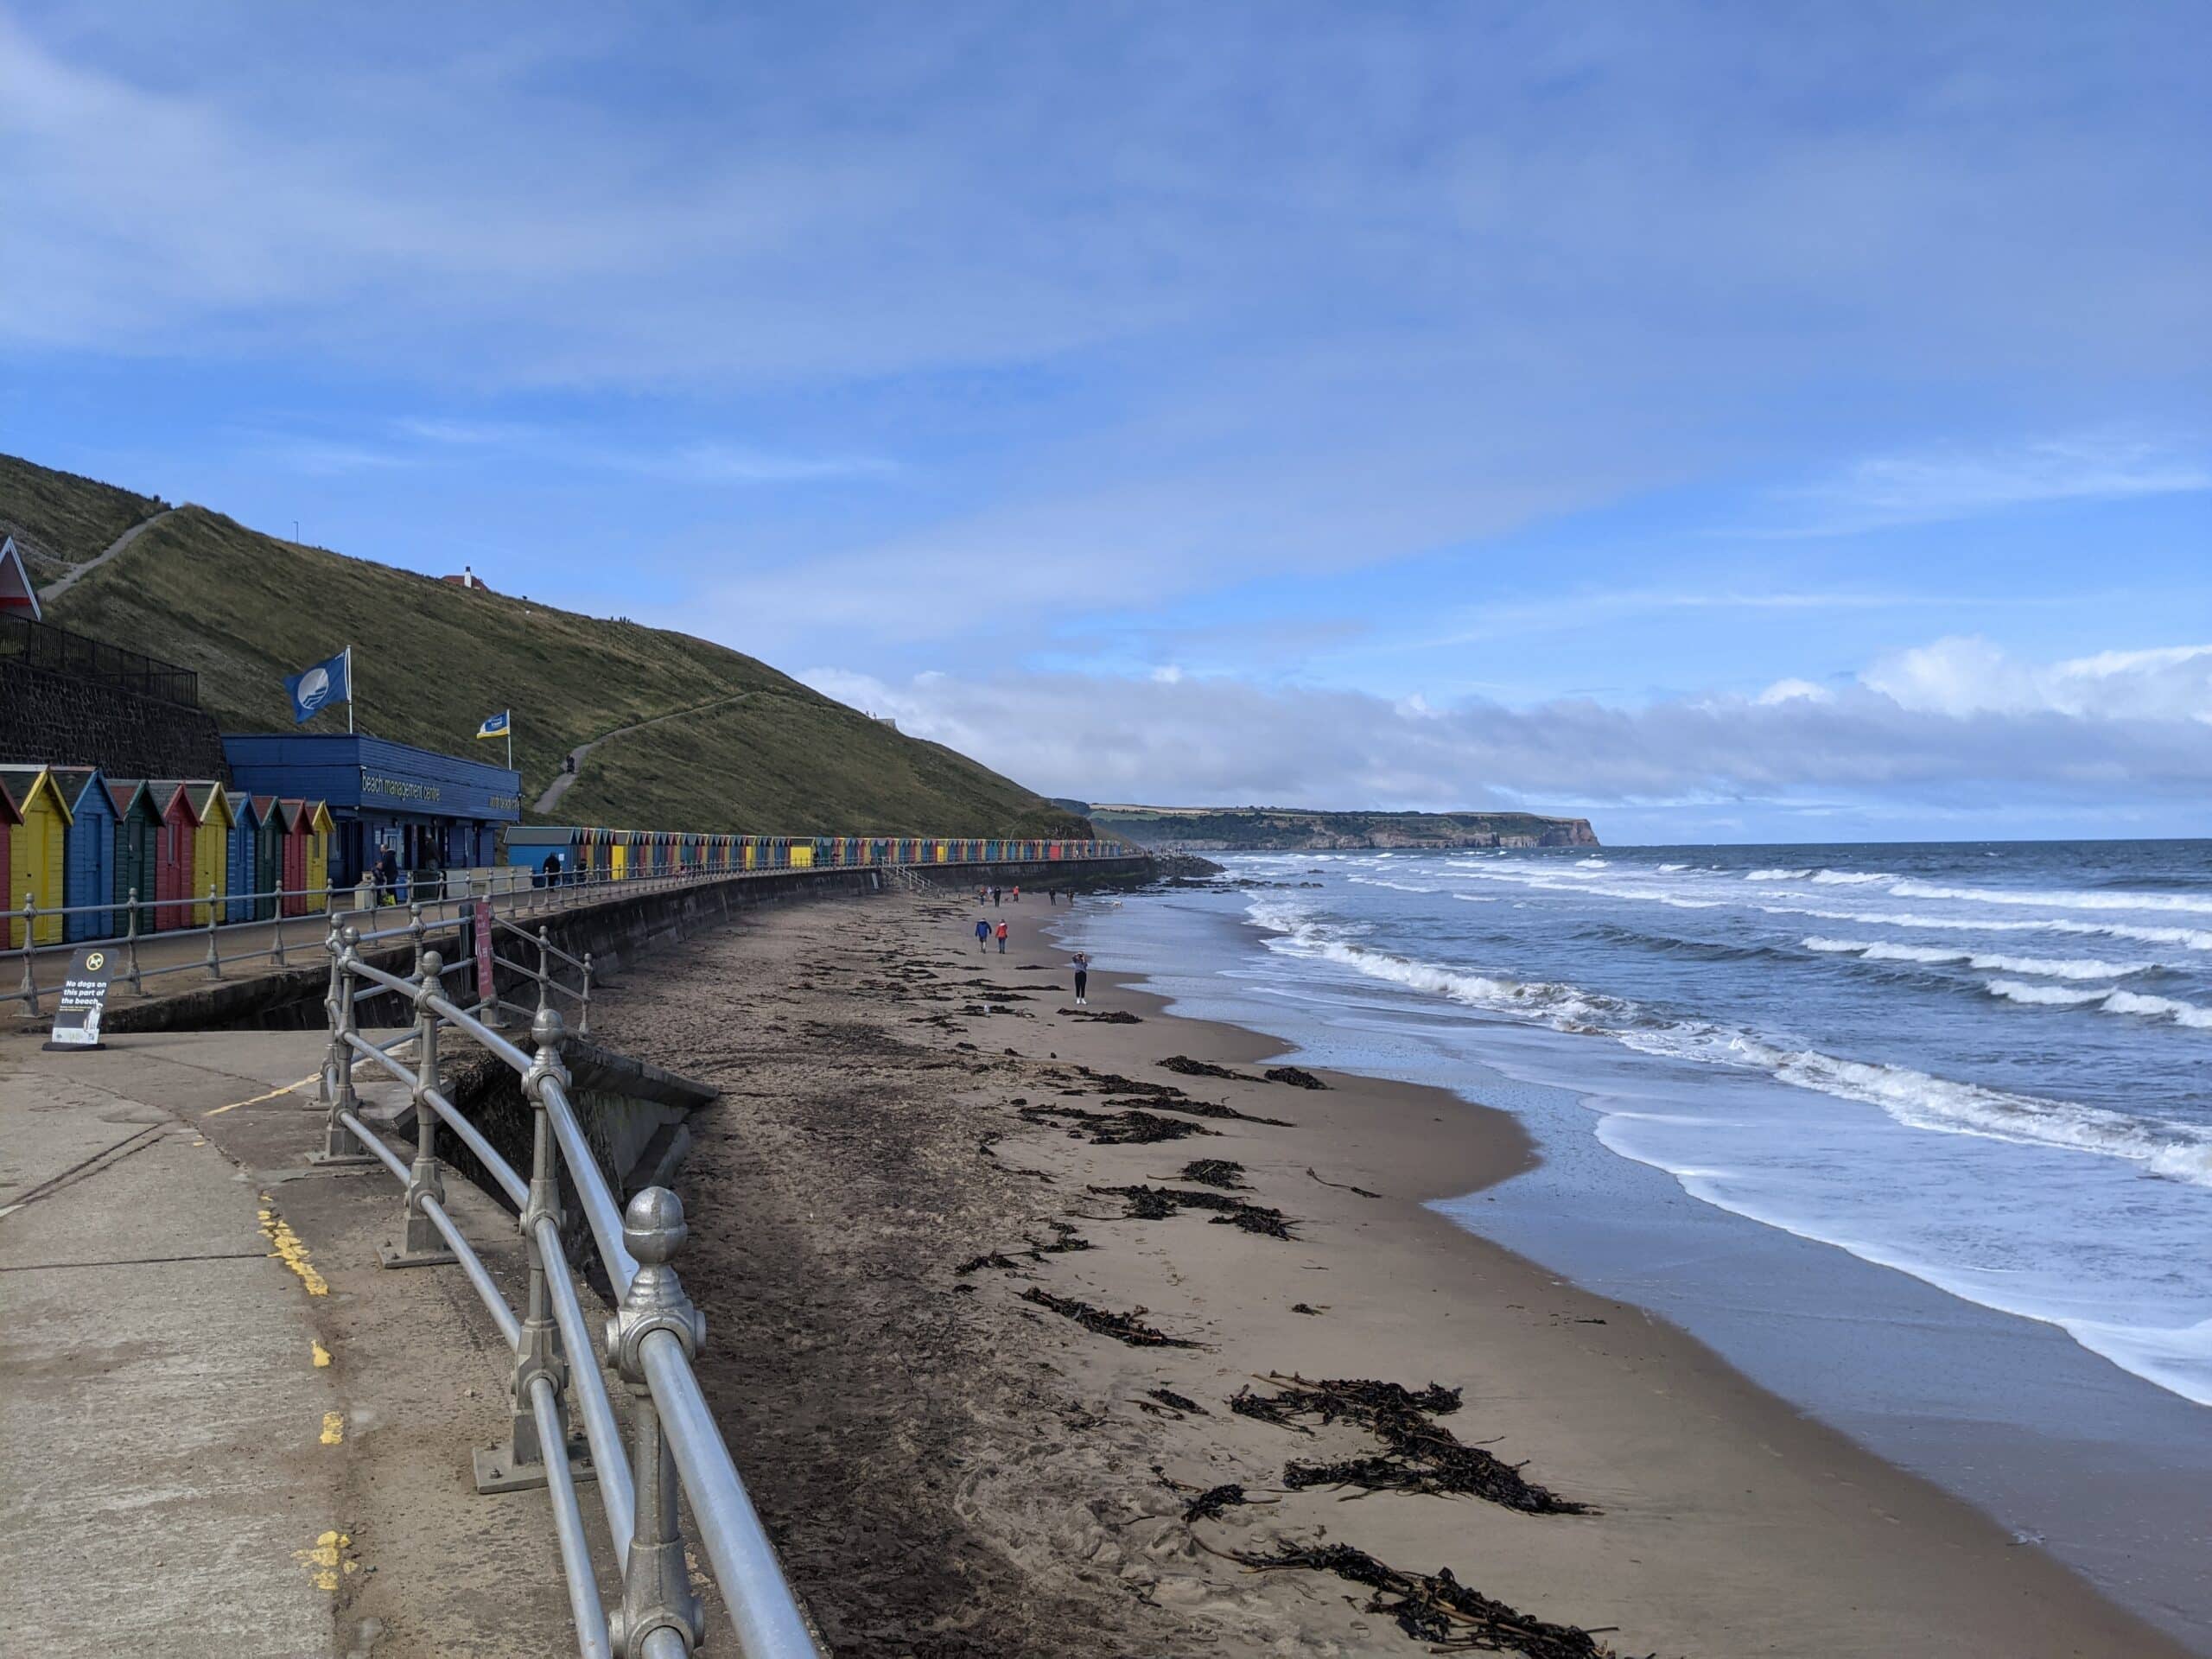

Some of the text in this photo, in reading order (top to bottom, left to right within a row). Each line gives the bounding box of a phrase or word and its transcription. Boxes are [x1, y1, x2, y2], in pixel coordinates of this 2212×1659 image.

[362, 772, 441, 802] beach management centre
